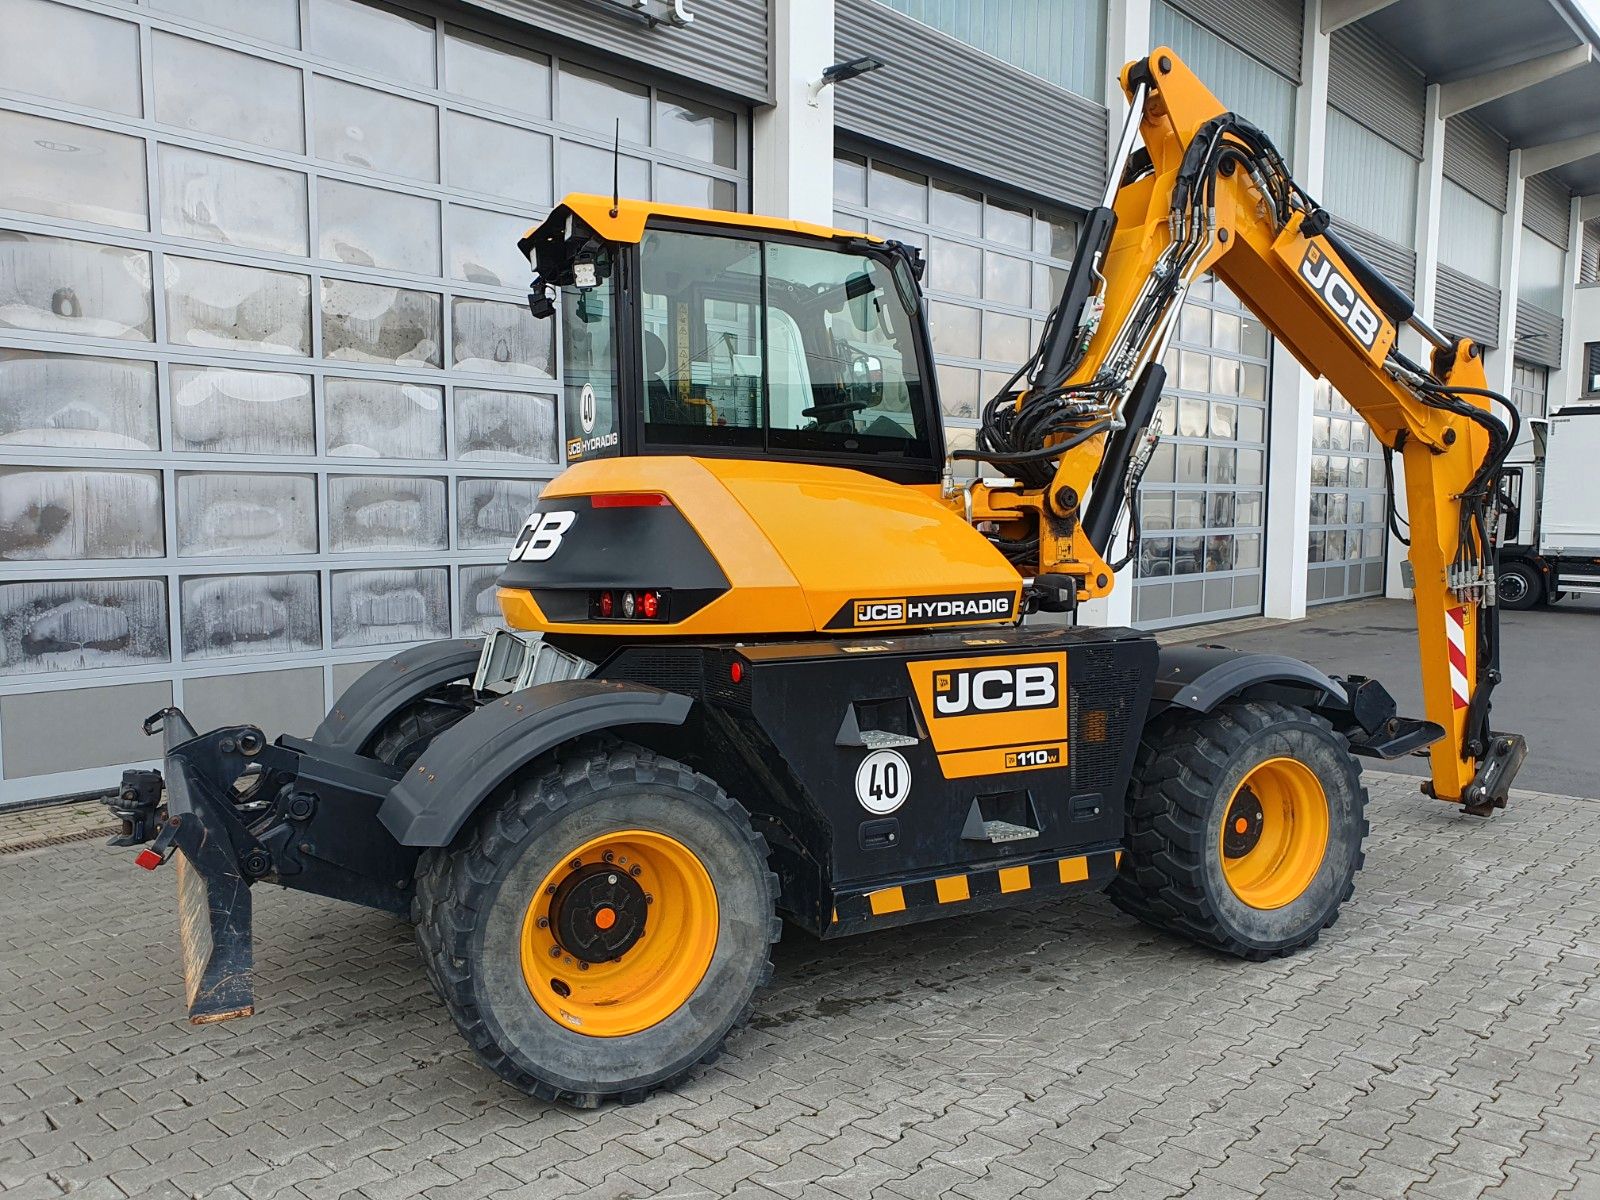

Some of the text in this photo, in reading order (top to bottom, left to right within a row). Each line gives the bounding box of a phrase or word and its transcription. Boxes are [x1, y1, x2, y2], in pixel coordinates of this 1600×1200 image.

[1302, 259, 1379, 346] JCB
[583, 393, 593, 423] 40
[568, 432, 618, 456] JCB HYDRADIG
[508, 510, 577, 562] CB
[858, 598, 1009, 621] JCB HYDRADIG
[936, 666, 1056, 714] JCB
[869, 762, 899, 801] 40
